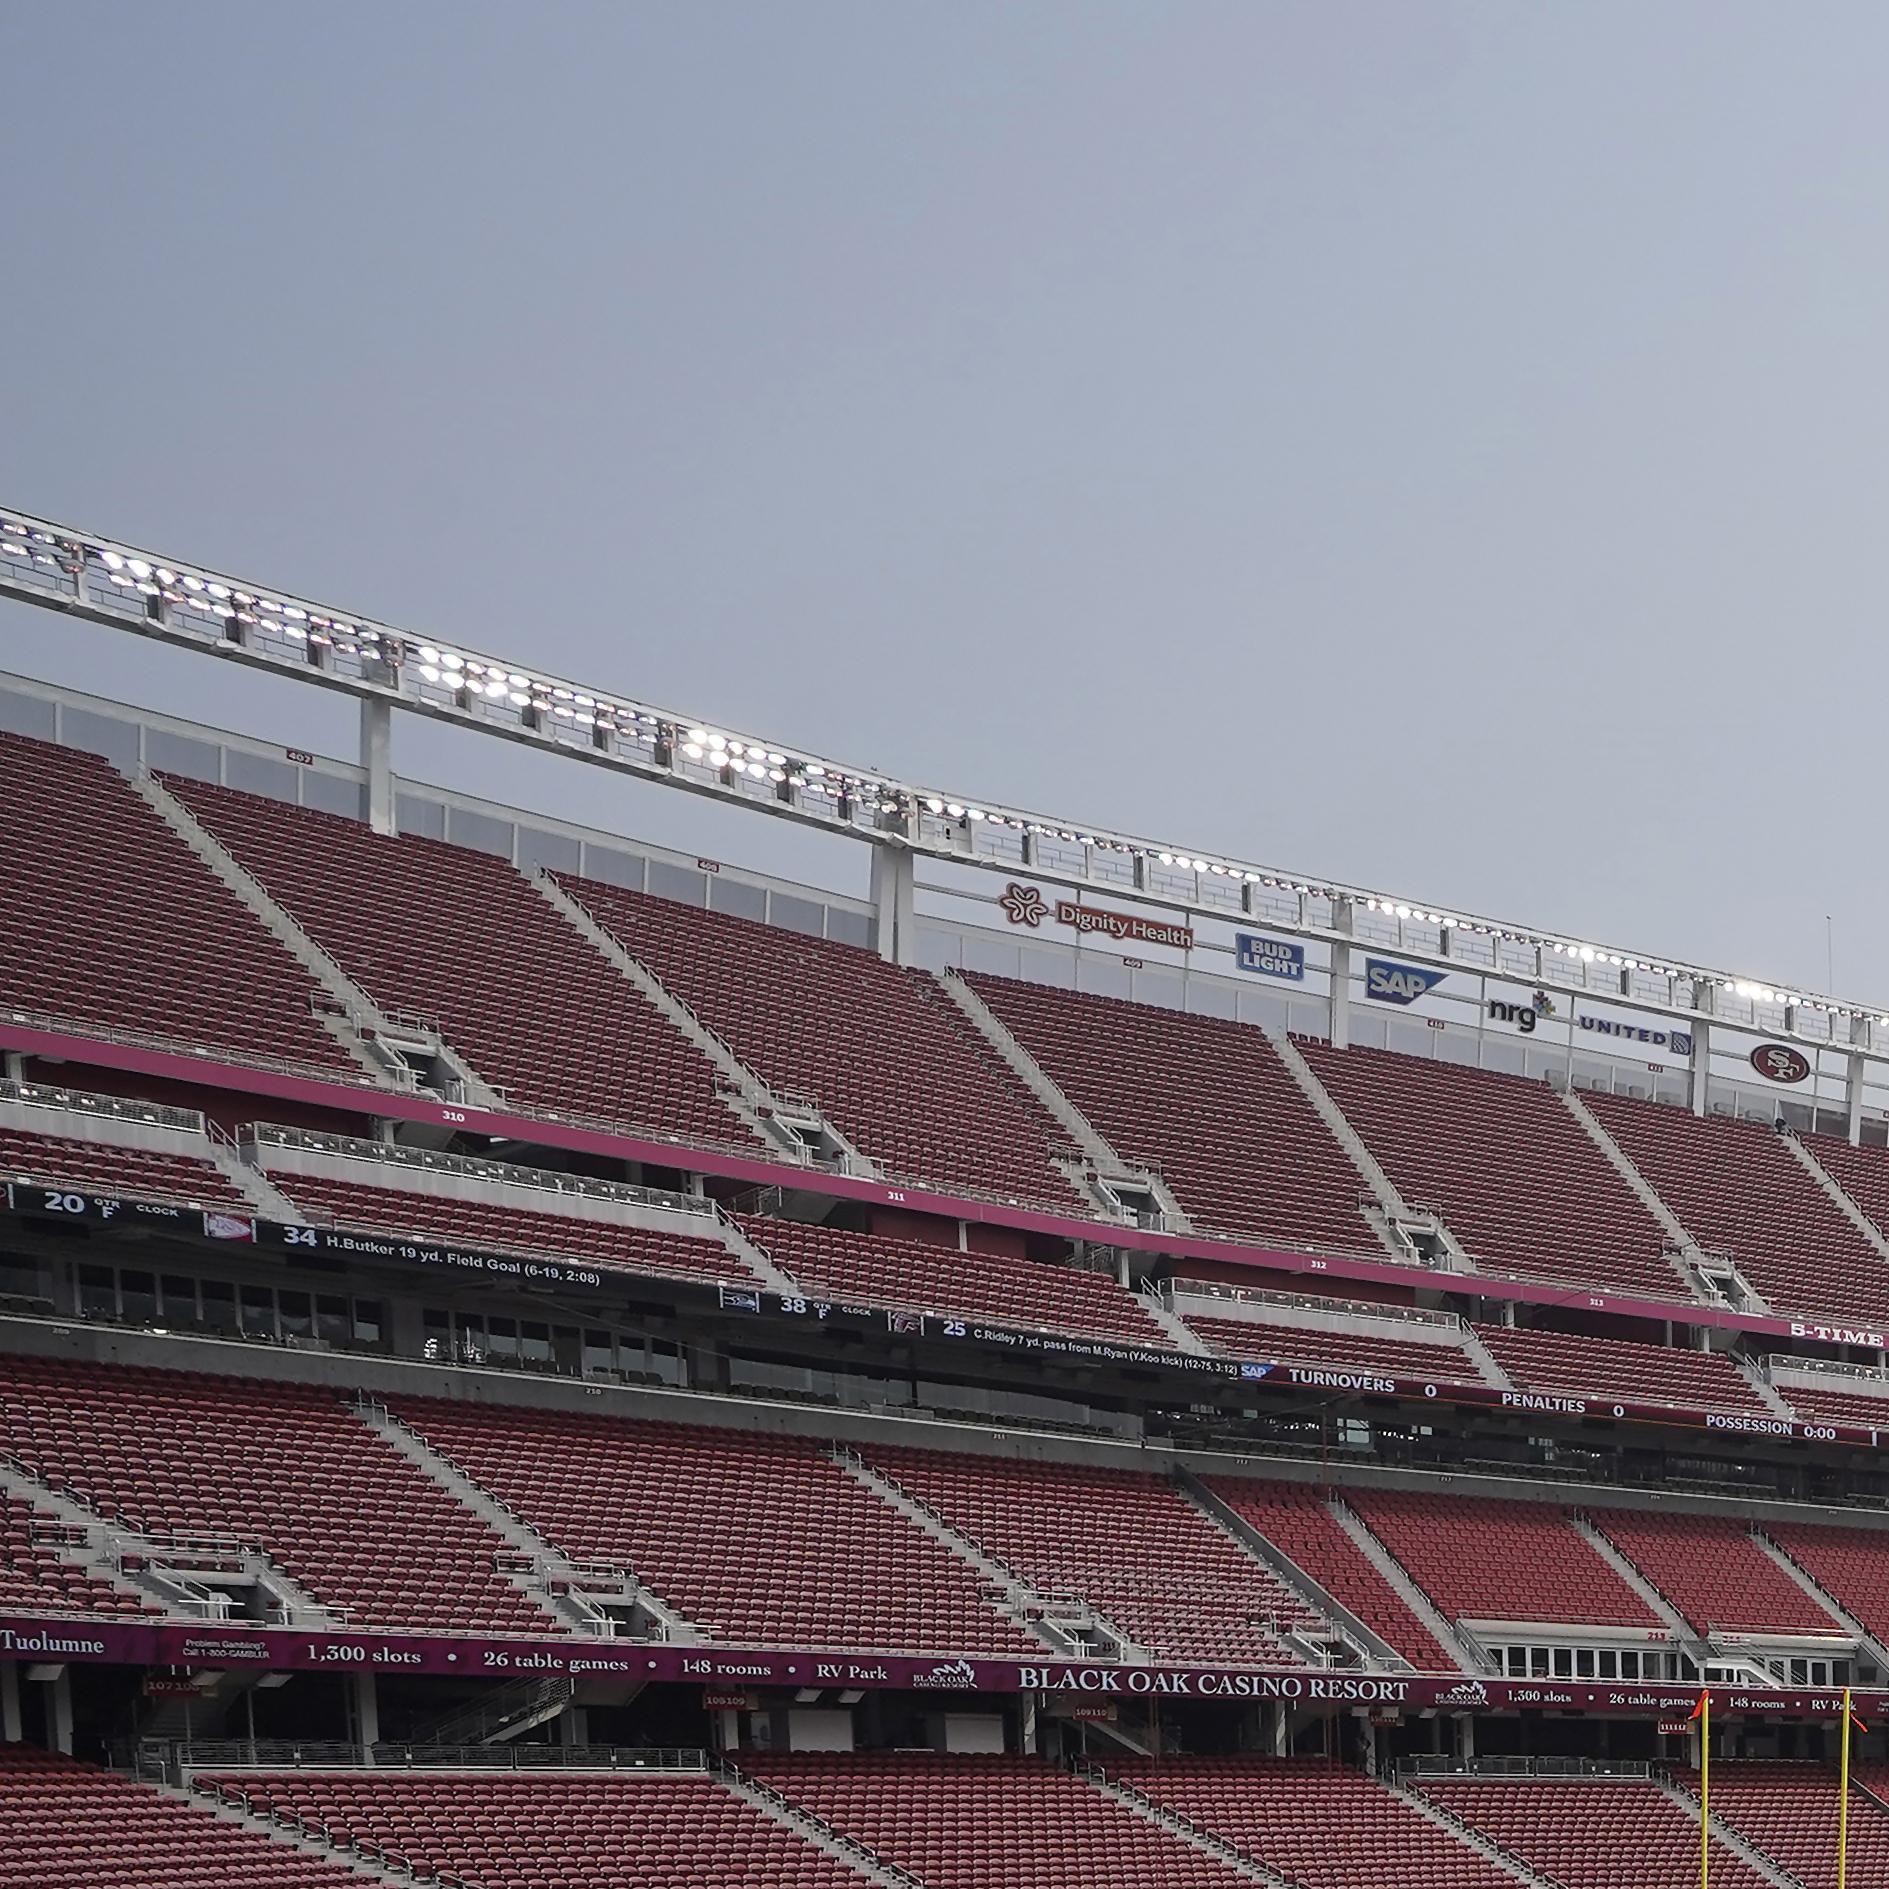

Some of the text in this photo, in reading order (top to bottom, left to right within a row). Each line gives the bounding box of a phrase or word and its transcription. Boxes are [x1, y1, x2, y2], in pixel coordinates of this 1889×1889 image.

[1060, 906, 1192, 947] Dignity Health
[1251, 941, 1292, 960] BUD
[1243, 953, 1302, 975] LIGHT
[1368, 966, 1426, 998] SAP
[1488, 999, 1536, 1033] nrg
[1579, 1015, 1667, 1046] UNITED
[442, 1110, 465, 1122] 310
[44, 1192, 178, 1217] 20 CLOCK
[888, 1191, 905, 1202] 311
[284, 1227, 600, 1286] 34 H.Butker 19 yd. Field Goal (6-19, 2:08)
[781, 1298, 806, 1313] 38
[1791, 1323, 1884, 1347] 5-TIME
[943, 1320, 1238, 1377] 25 C.Ridley pass from M.Ryan 3:12)
[1241, 1365, 1836, 1440] SAP TURNOVERS PENALTIES POSSESSION 0:00
[0, 1630, 104, 1654] Tuolumne
[201, 1649, 270, 1659] 1-800-GAMBLER
[222, 1640, 265, 1651] Gambling?
[309, 1645, 887, 1680] 1,300 slots 26 table games 148 rooms RV Park
[1019, 1667, 1408, 1701] BLACK OAK CASINO RESORT
[1507, 1690, 1829, 1711] 1,300 slots 26 table games rooms RV
